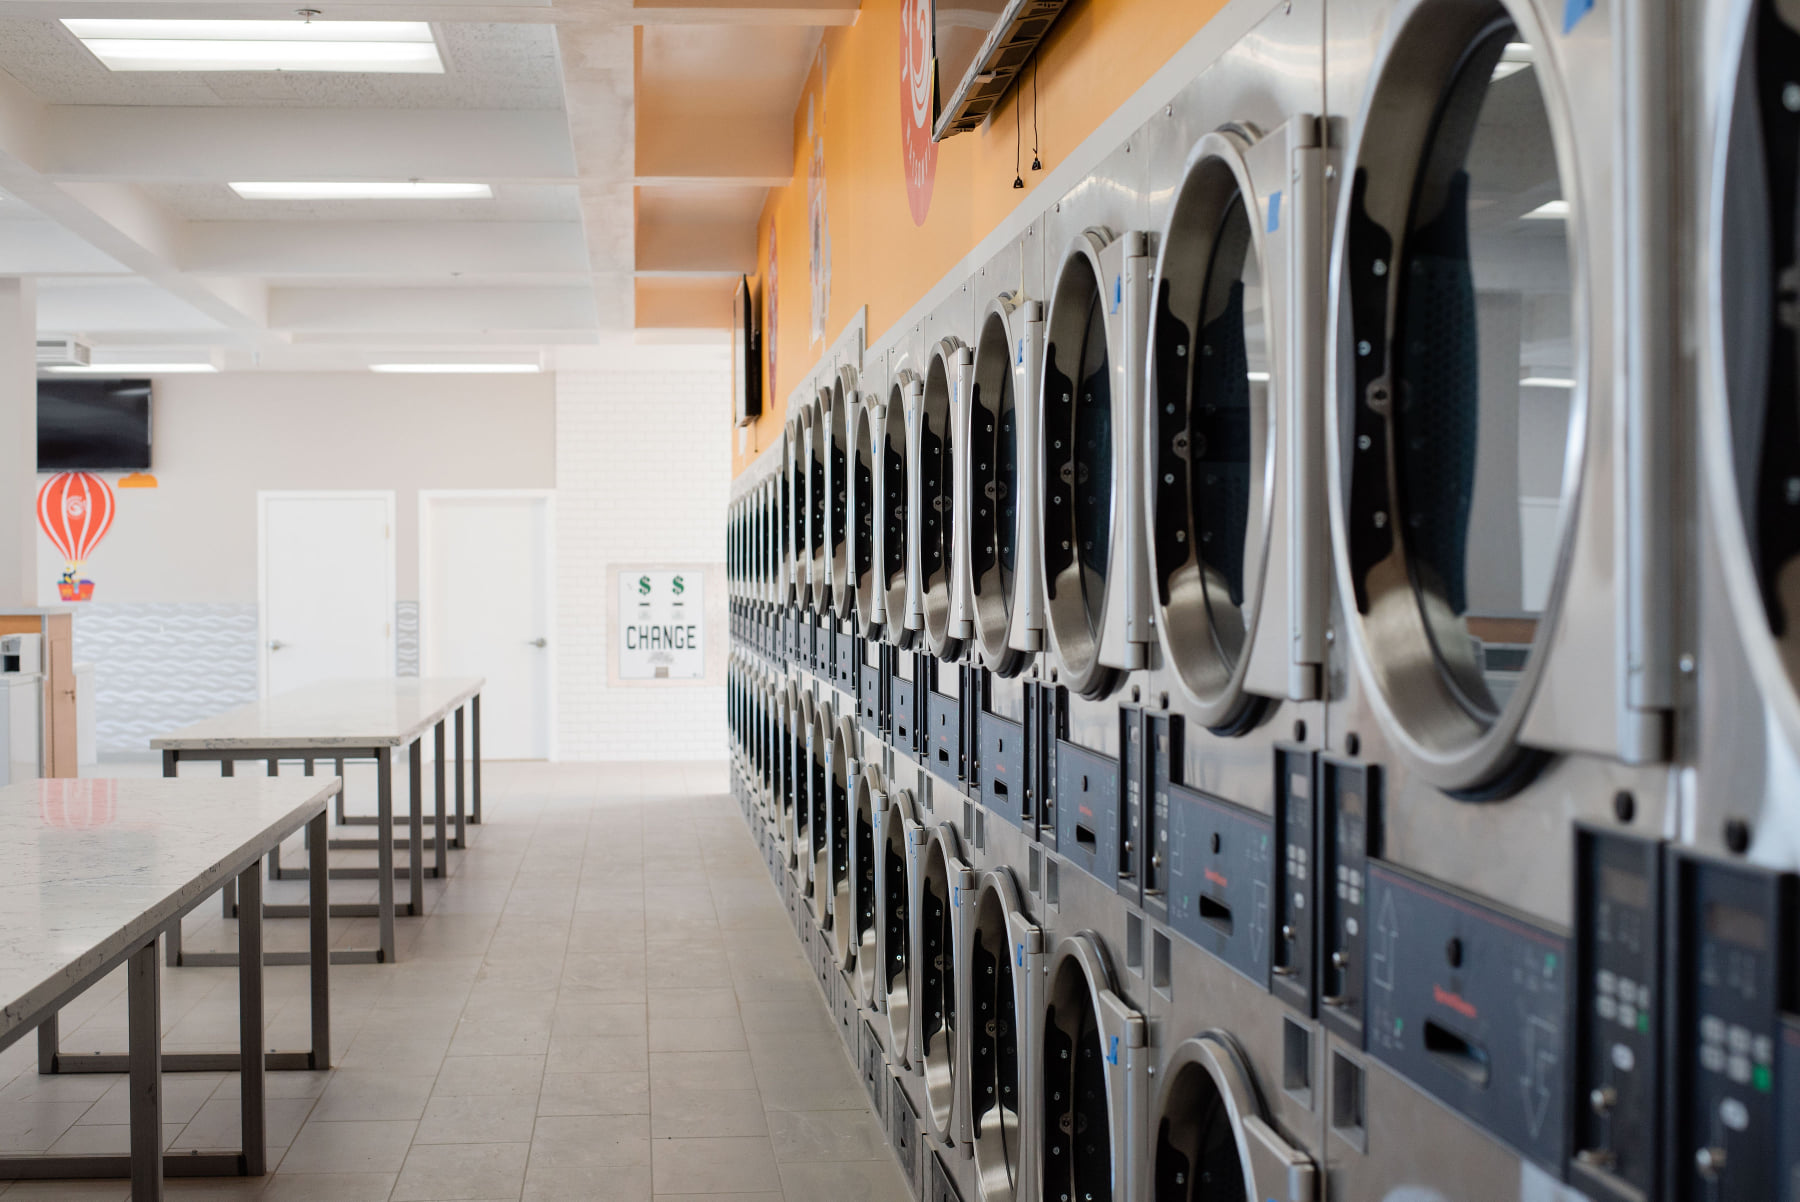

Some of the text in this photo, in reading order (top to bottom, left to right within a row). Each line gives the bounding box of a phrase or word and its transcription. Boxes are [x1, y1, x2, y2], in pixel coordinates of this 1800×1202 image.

[639, 576, 684, 595] $ $
[626, 625, 697, 650] CHANGE
